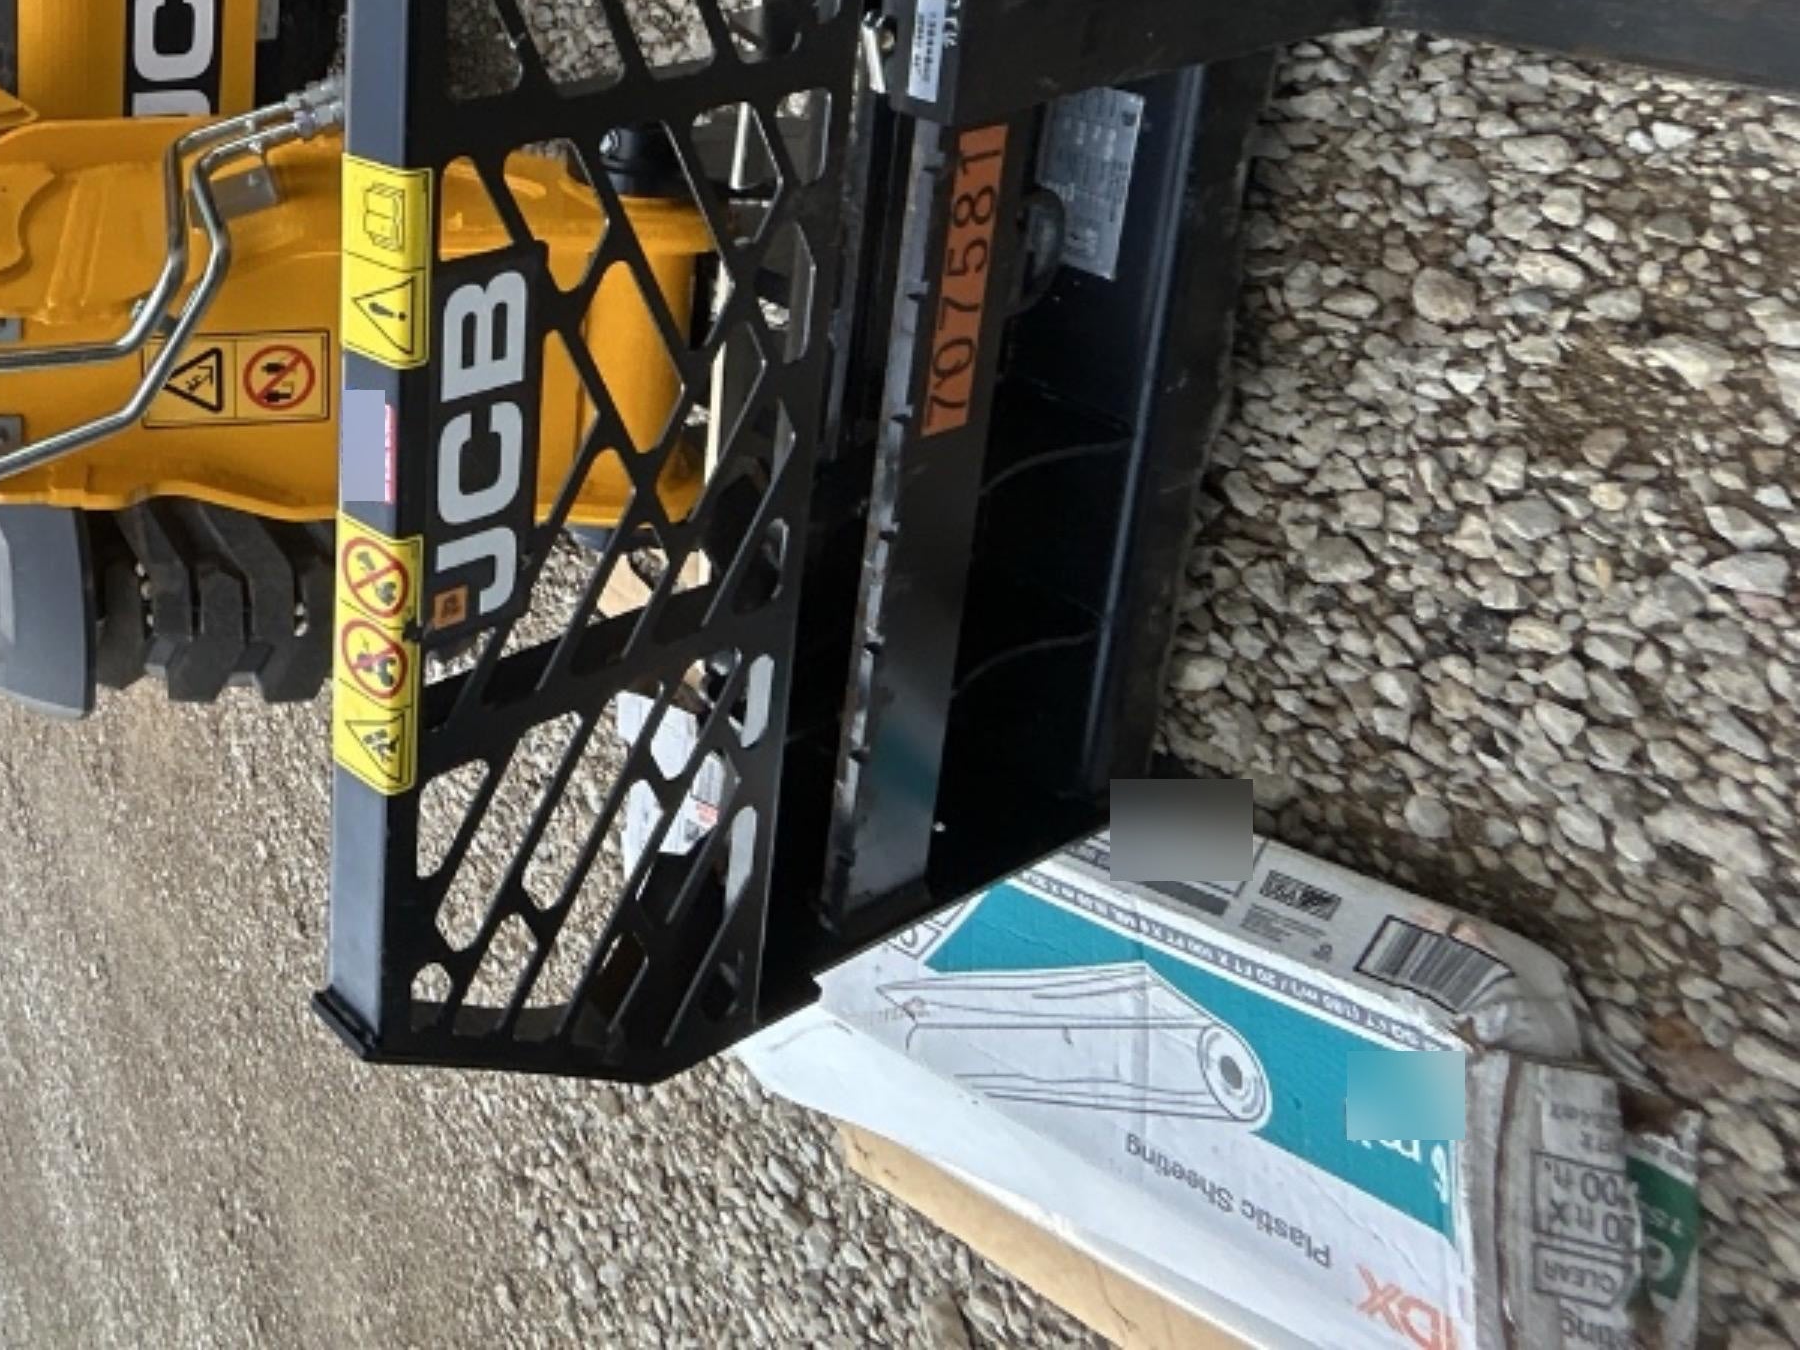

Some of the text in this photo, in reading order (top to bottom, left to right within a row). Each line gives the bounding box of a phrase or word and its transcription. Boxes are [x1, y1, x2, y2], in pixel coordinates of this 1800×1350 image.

[433, 269, 528, 616] JCB
[1125, 1132, 1332, 1268] Plastic Sheeting
[1544, 1259, 1616, 1296] CLEAR
